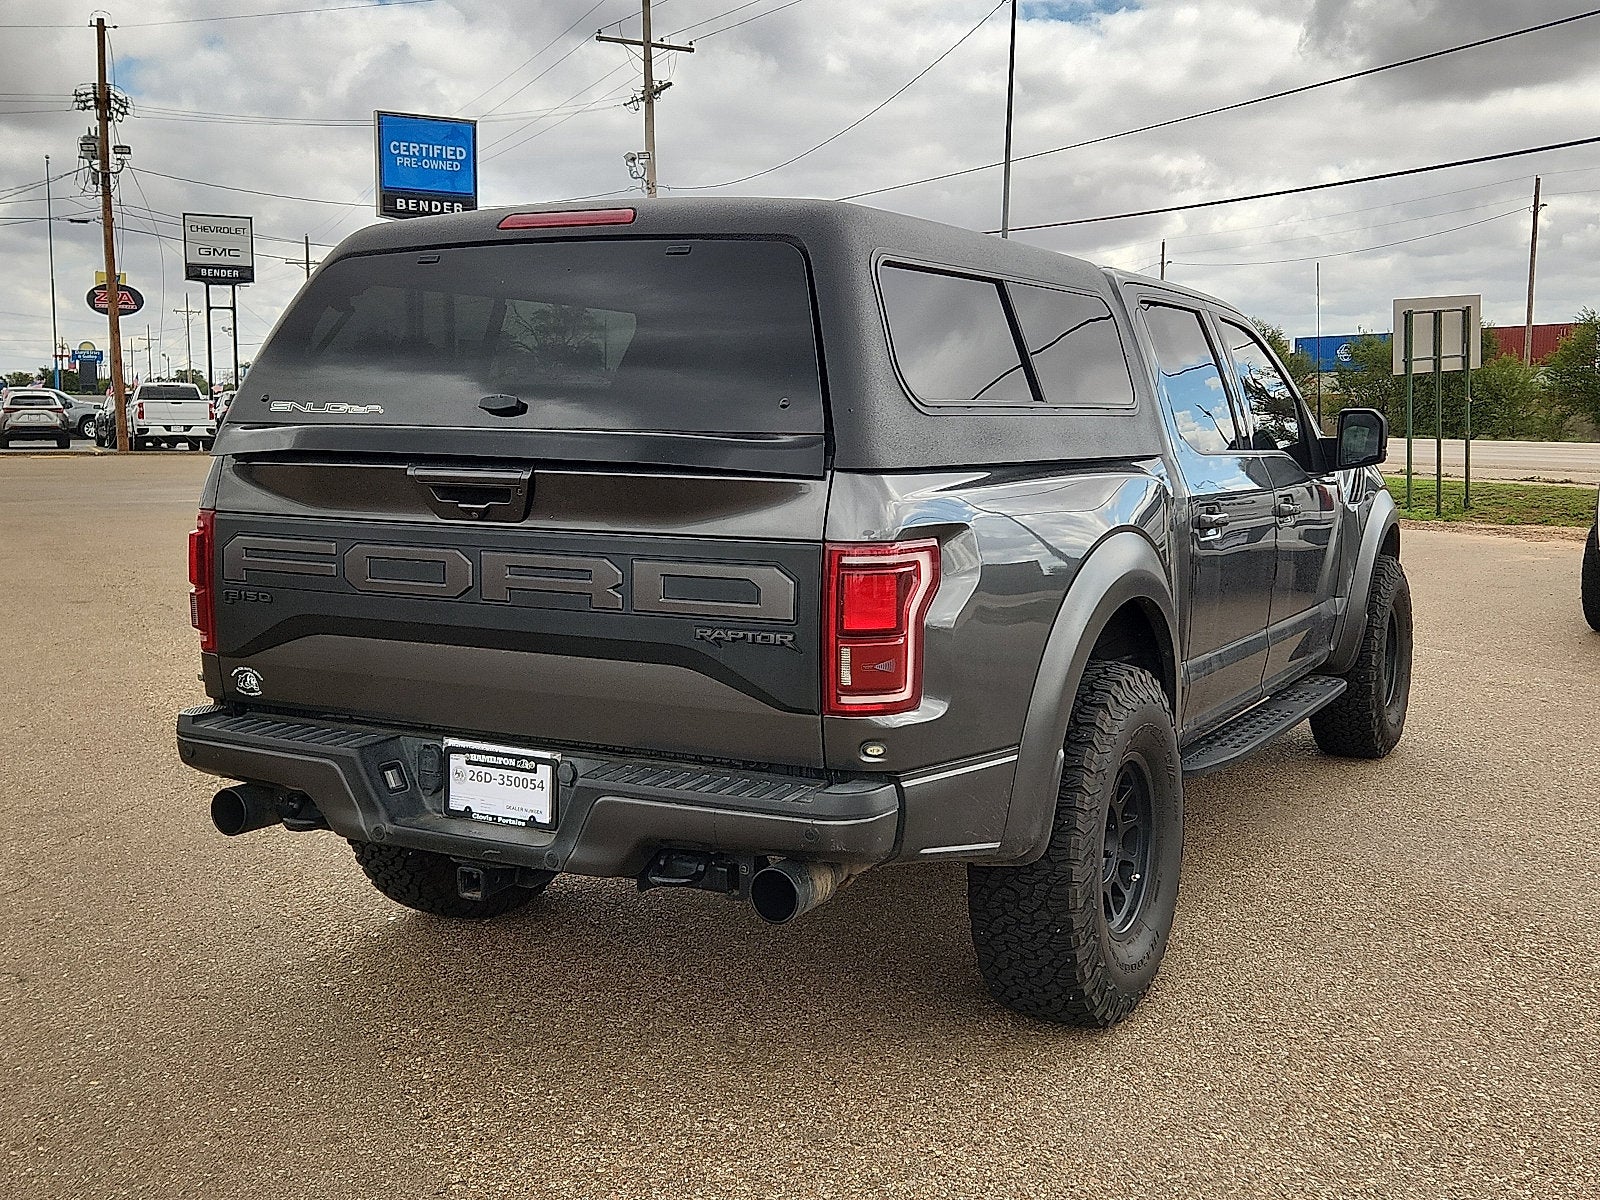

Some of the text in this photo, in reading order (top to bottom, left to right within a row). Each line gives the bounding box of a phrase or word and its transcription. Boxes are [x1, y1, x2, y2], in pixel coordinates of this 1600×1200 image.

[390, 141, 467, 160] CERTIFIED
[396, 156, 461, 171] PRE-OWNED
[396, 198, 463, 213] BENDER
[190, 224, 248, 235] CHEVROLET
[198, 247, 241, 257] GMC
[200, 268, 240, 278] BENDER
[94, 290, 136, 304] ZA
[223, 533, 797, 621] FORD
[694, 626, 803, 654] RAPTOR
[470, 753, 516, 767] HAMILTON
[468, 769, 545, 792] 26D-350054
[471, 812, 526, 827] Clovis Portales
